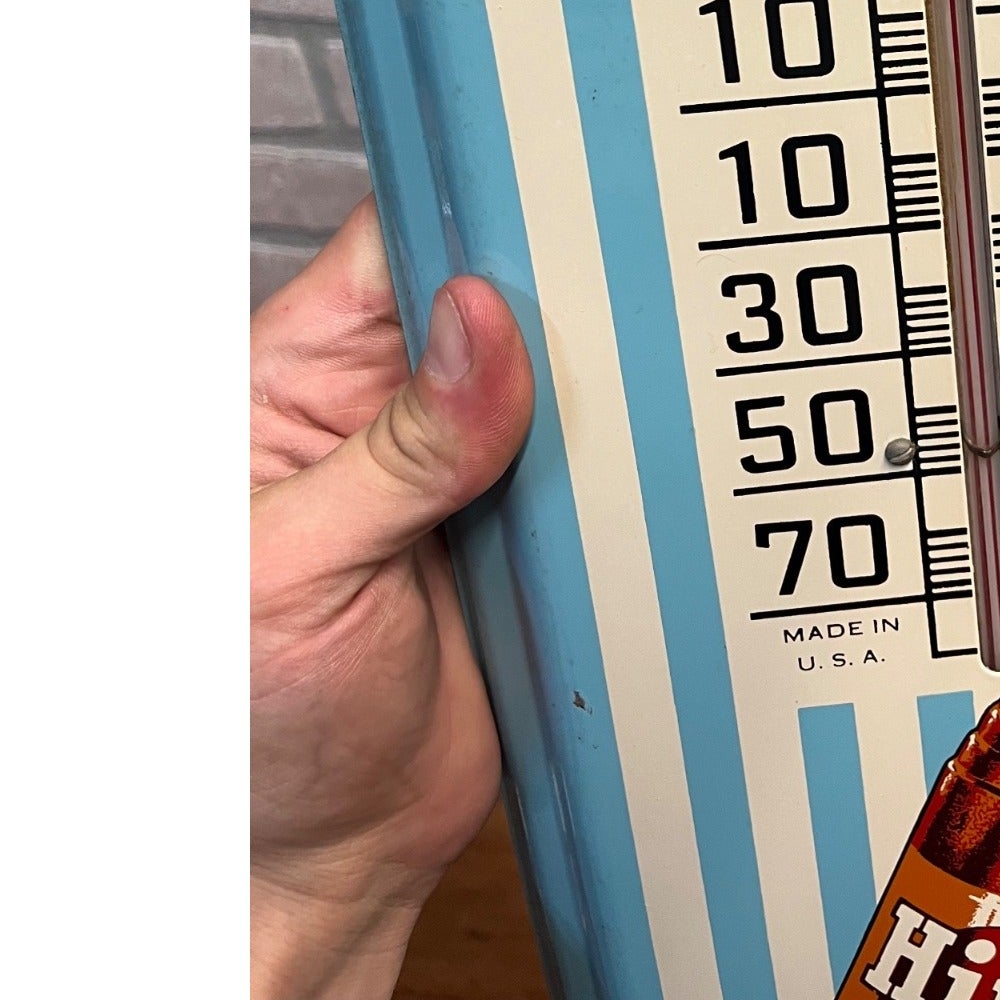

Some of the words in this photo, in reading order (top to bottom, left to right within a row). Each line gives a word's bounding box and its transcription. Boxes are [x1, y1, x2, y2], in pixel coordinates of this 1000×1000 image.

[718, 133, 850, 225] 10
[720, 264, 863, 354] 30
[734, 388, 874, 474] 50
[754, 513, 889, 596] 70
[782, 620, 864, 644] MADE
[872, 616, 900, 635] IN
